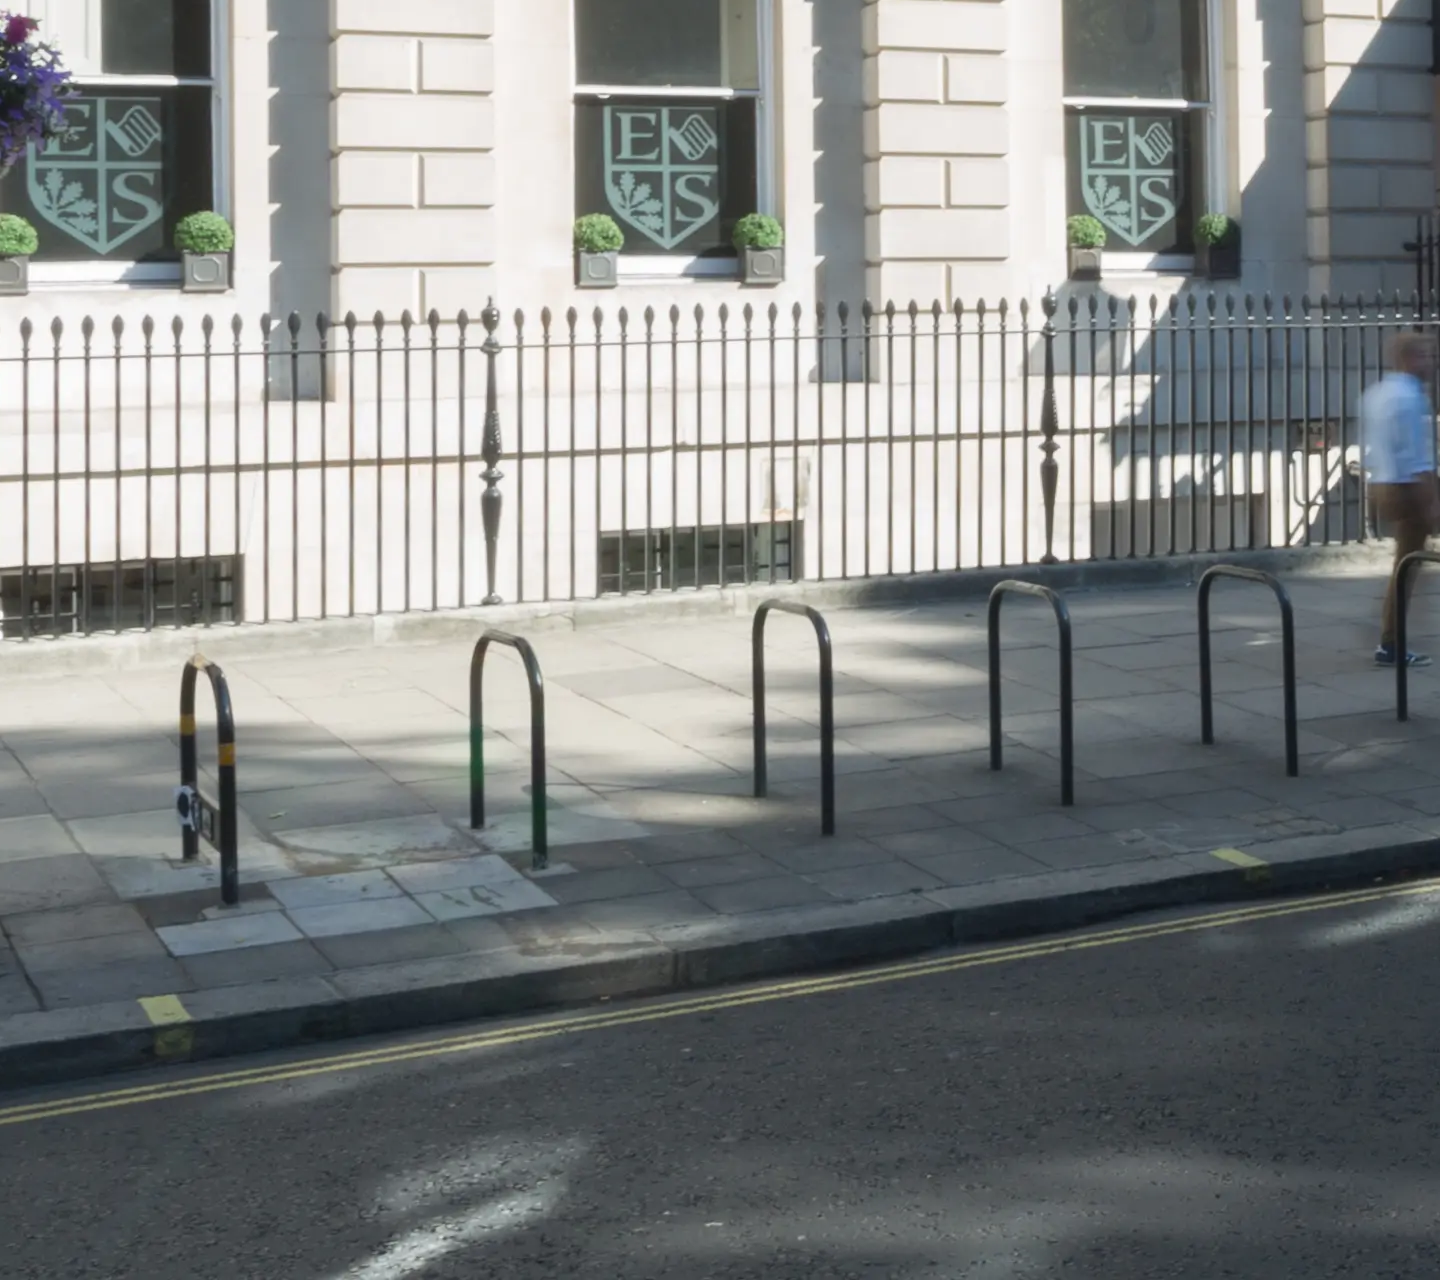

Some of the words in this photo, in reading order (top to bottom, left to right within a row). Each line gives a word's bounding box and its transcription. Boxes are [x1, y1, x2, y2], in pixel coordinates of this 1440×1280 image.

[615, 112, 660, 160] E
[1090, 121, 1127, 165] E
[112, 171, 162, 224] S
[674, 174, 718, 222] S
[1140, 177, 1175, 222] S
